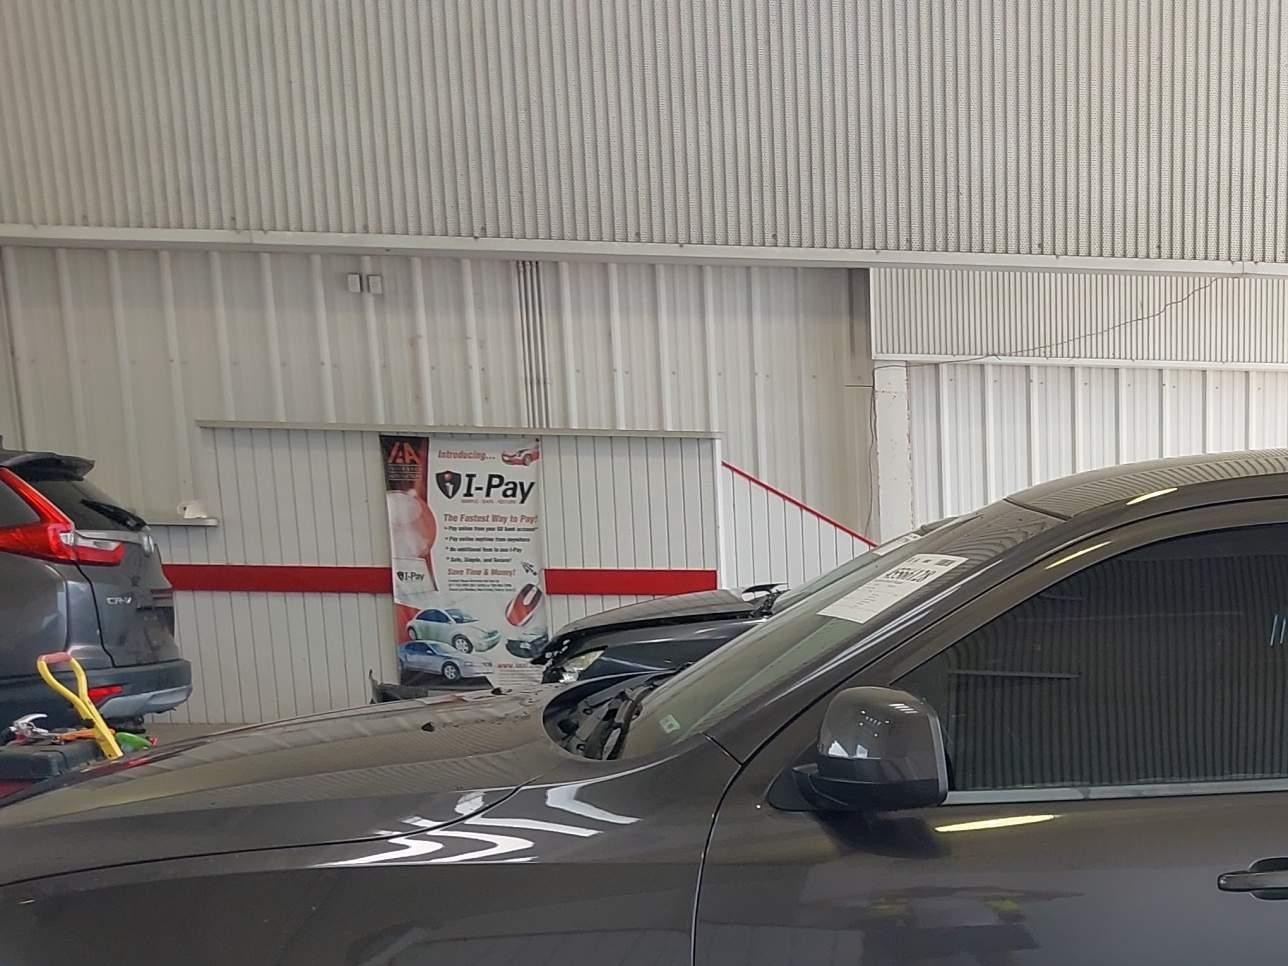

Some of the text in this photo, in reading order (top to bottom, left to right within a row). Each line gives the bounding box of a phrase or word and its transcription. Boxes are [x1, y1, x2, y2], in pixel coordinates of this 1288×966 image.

[438, 449, 496, 461] Introducing...
[463, 473, 536, 504] I-Pay
[444, 513, 458, 522] The
[460, 513, 490, 523] Fastest
[492, 514, 508, 524] Way
[510, 515, 518, 523] to
[404, 571, 425, 581] I-Pay
